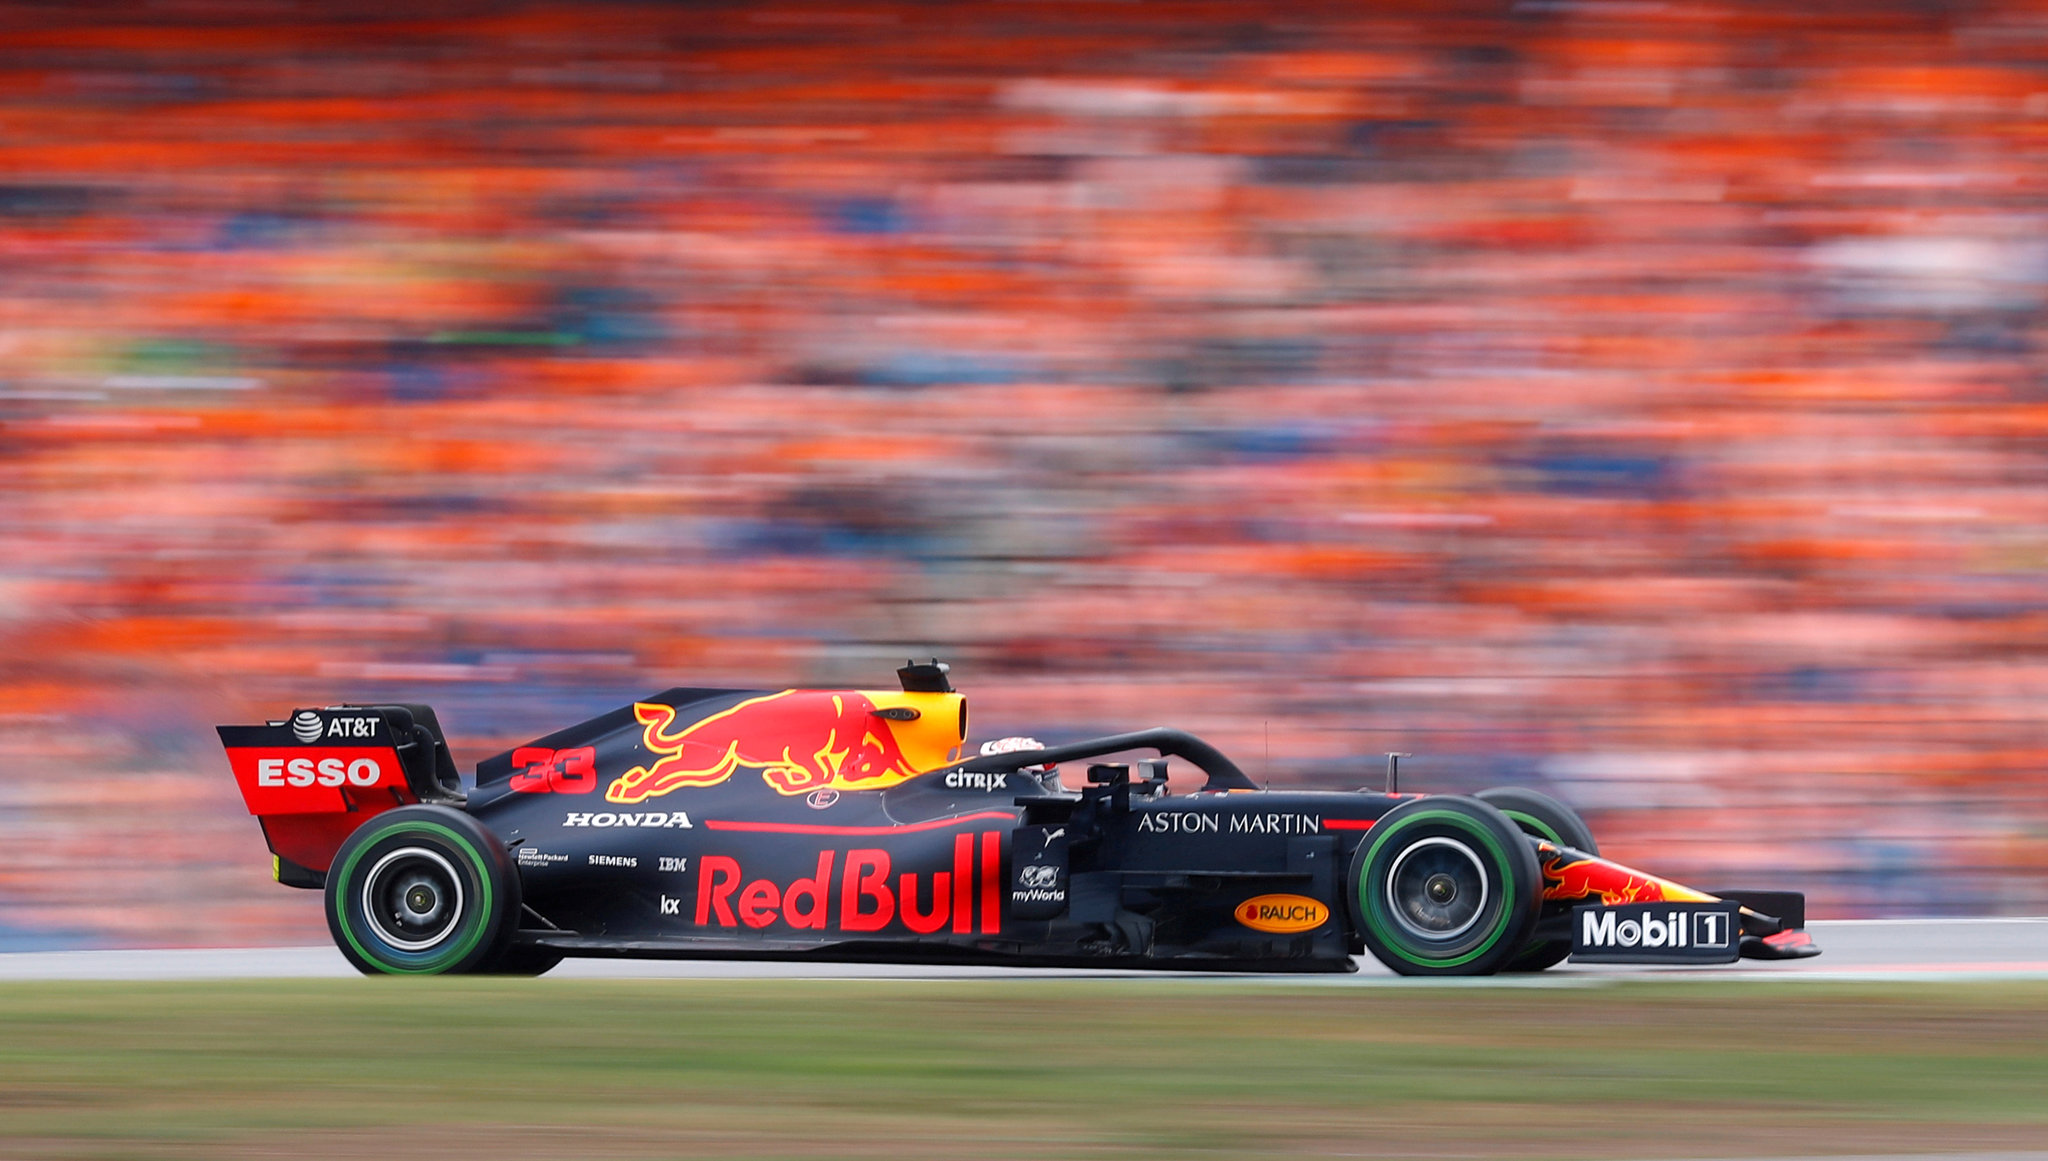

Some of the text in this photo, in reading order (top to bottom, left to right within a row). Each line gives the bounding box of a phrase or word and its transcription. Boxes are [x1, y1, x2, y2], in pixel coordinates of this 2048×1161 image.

[327, 717, 380, 738] AT&T
[258, 758, 381, 787] ESSO
[510, 747, 597, 793] 33
[562, 811, 693, 829] HONDA
[1137, 812, 1320, 834] ASTON MARTIN
[543, 854, 569, 863] Packard
[588, 854, 638, 868] SIEMENS
[658, 857, 687, 872] IBM
[695, 831, 1000, 934] Red Bull
[661, 895, 680, 914] kx
[1012, 888, 1065, 902] myWorld
[1259, 904, 1317, 922] RAUCH
[1582, 911, 1688, 948] Mobil
